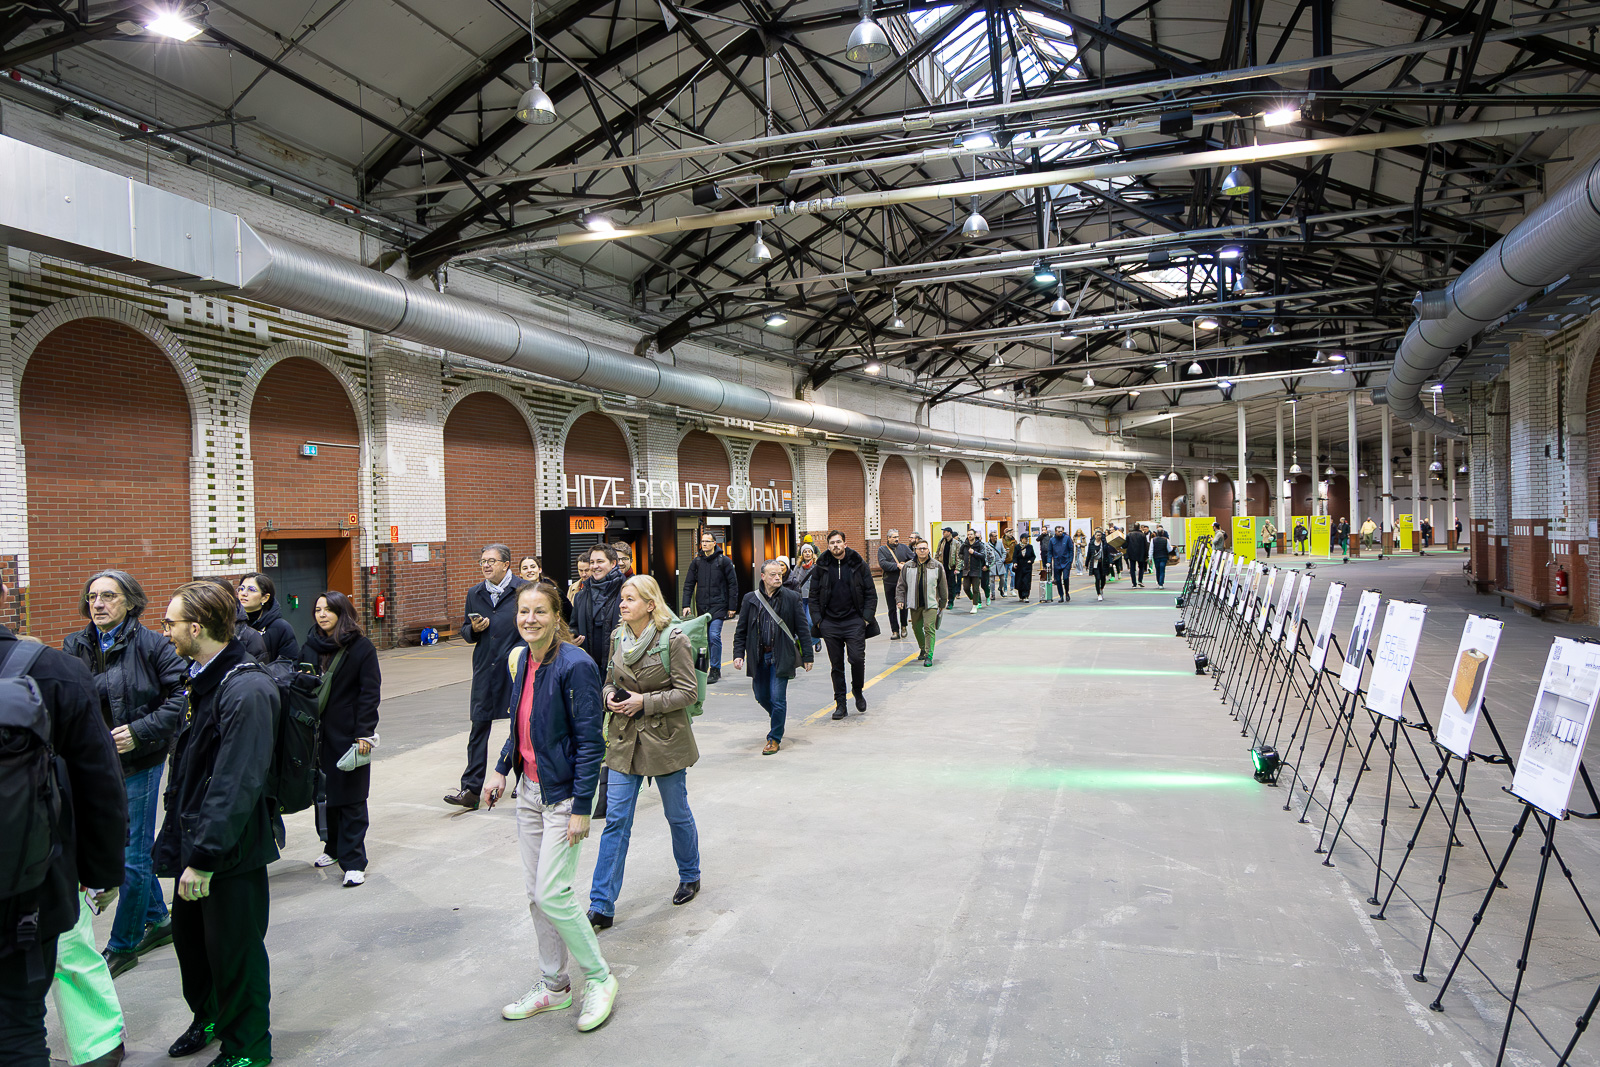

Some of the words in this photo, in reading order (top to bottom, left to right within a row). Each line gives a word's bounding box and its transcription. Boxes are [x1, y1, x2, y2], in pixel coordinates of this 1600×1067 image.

[563, 474, 630, 508] HITZE.
[634, 478, 723, 511] RESILIENZ.
[726, 482, 782, 511] SPÜREN.
[575, 519, 595, 529] roma
